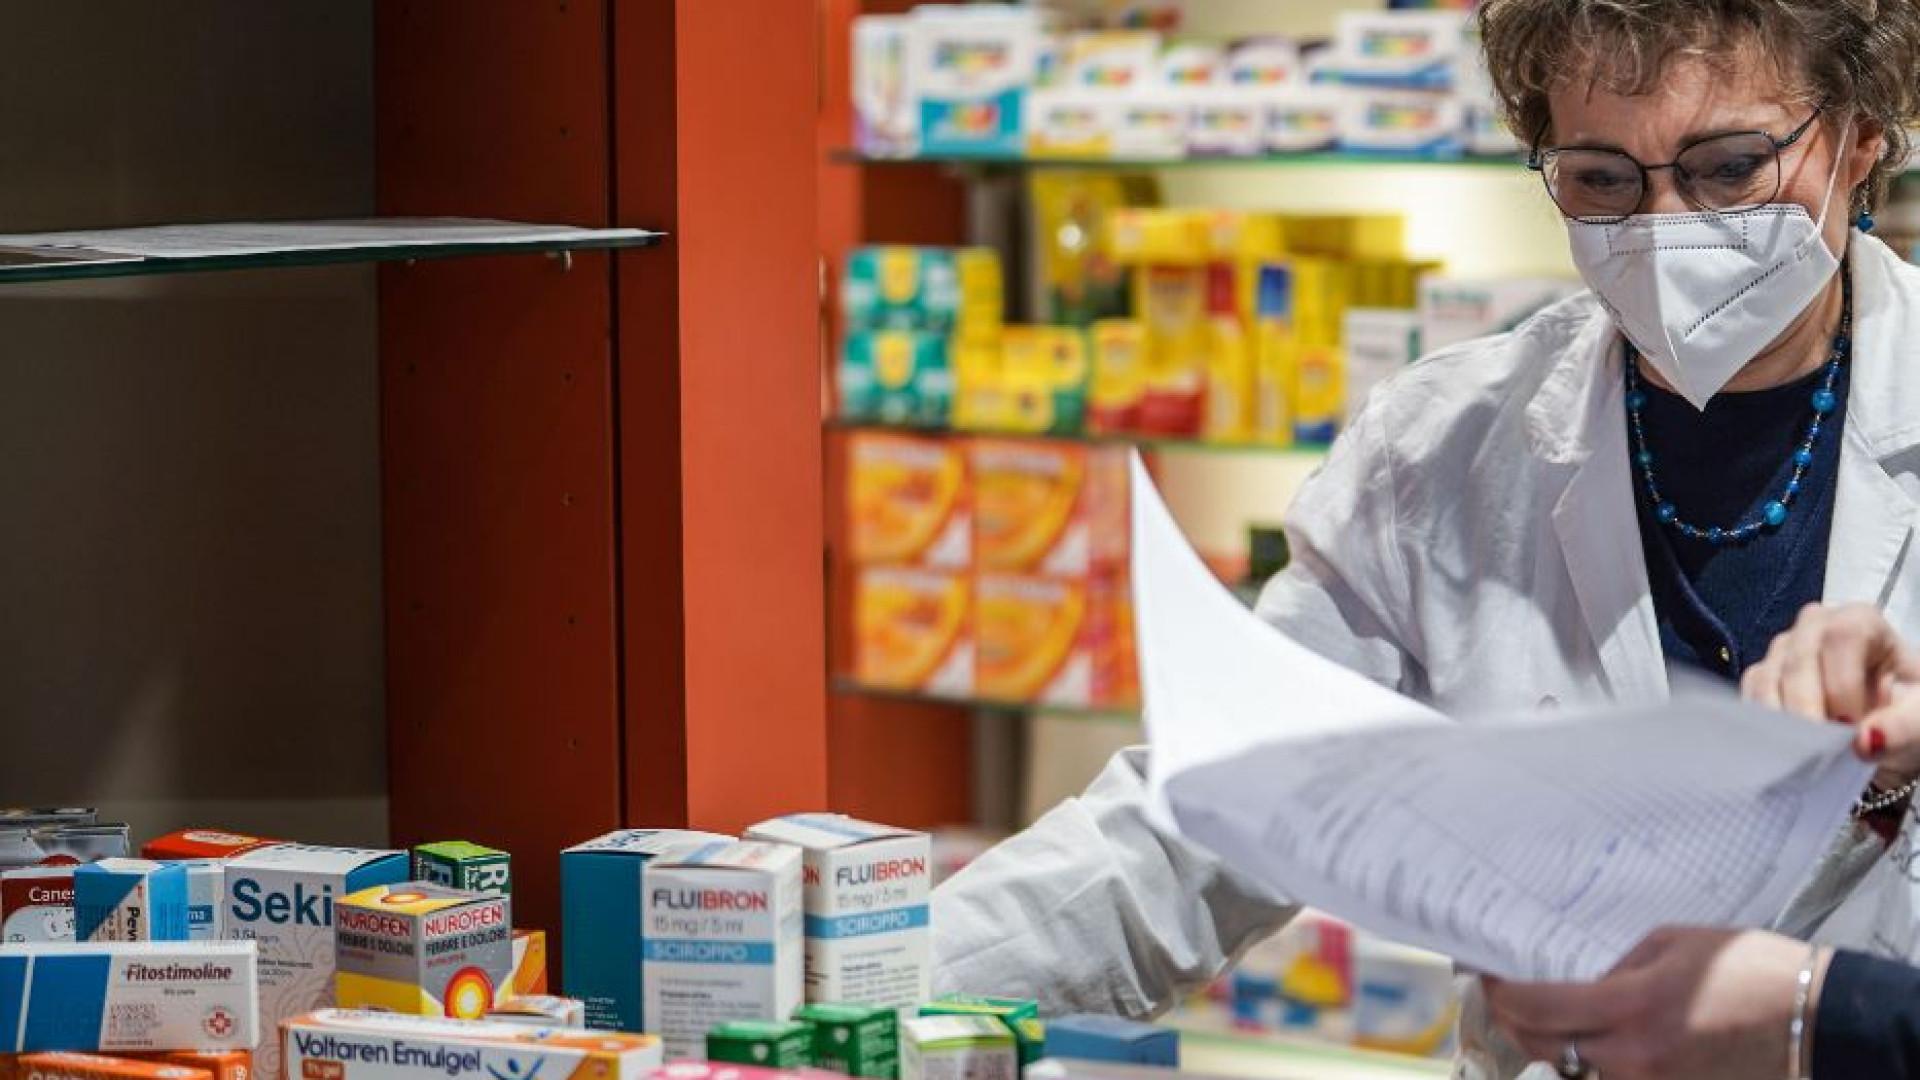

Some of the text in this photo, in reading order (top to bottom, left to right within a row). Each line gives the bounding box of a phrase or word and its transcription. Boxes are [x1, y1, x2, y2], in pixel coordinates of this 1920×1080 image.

[836, 857, 925, 887] FLUIBRON
[232, 877, 332, 927] Seki
[652, 888, 768, 911] FLUIBRON
[338, 911, 412, 937] NUROFEN
[426, 904, 504, 937] NUROFEN
[127, 963, 232, 981] Fitostimoline
[294, 1030, 481, 1076] Voltaren Emulgel
